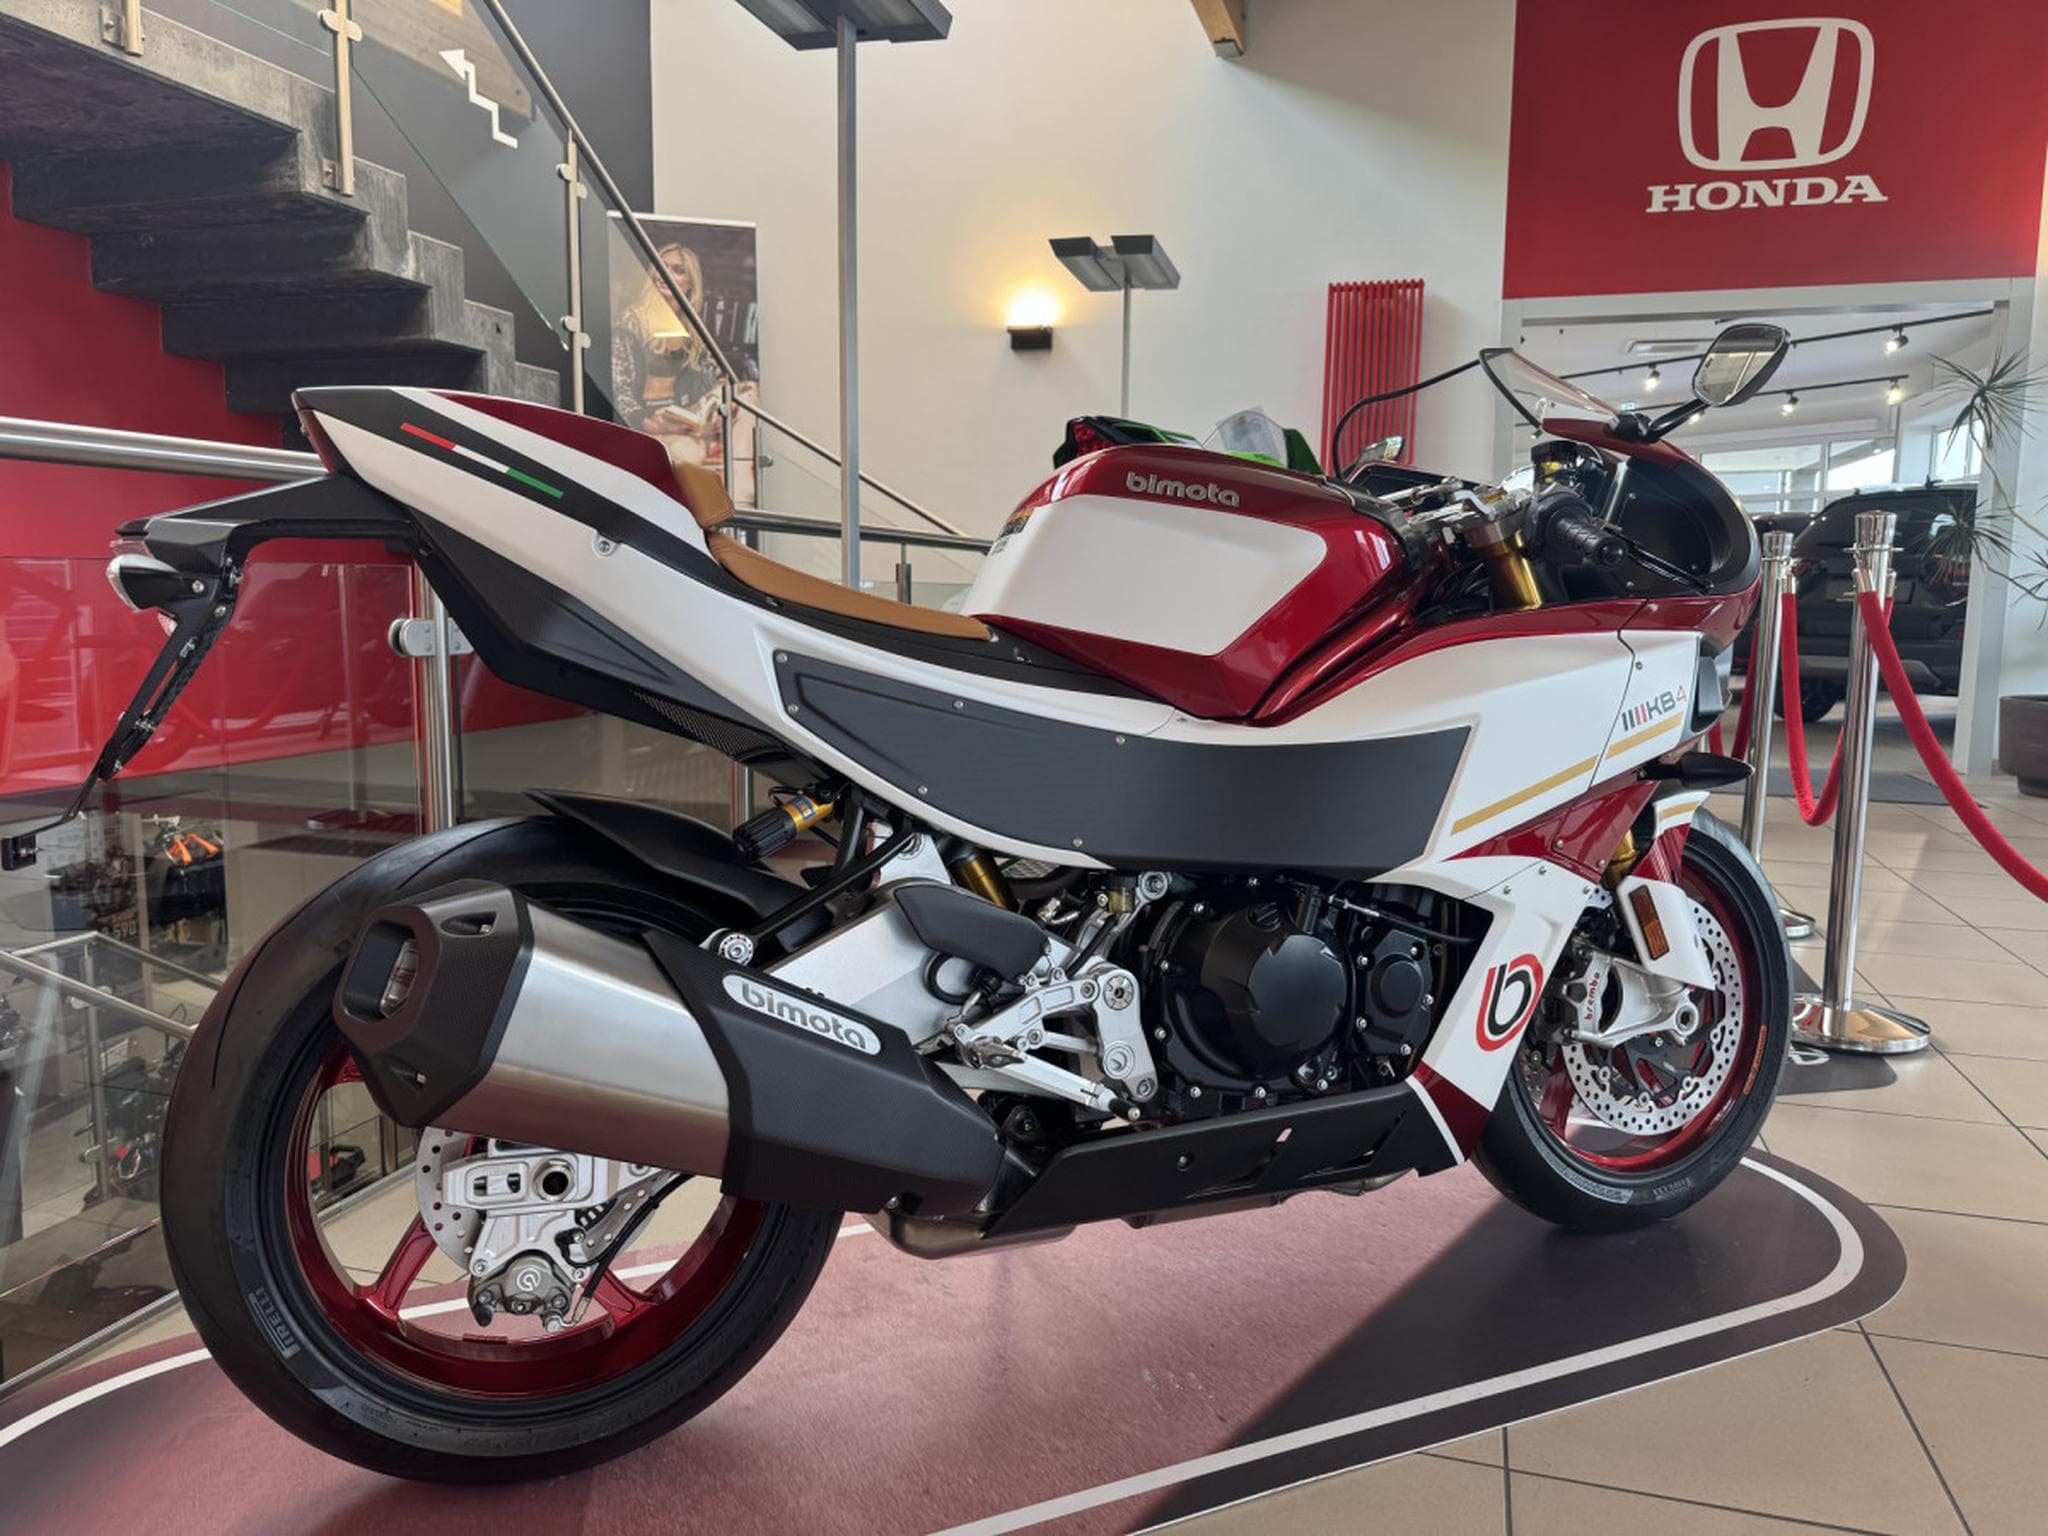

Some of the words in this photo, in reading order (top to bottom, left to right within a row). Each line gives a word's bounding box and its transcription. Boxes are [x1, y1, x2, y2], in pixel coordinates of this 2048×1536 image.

[1646, 173, 1888, 213] HONDA
[1126, 471, 1240, 508] bimota
[741, 981, 867, 1050] bimota
[1583, 971, 1601, 1021] brembo
[248, 1287, 300, 1360] PIRELLI
